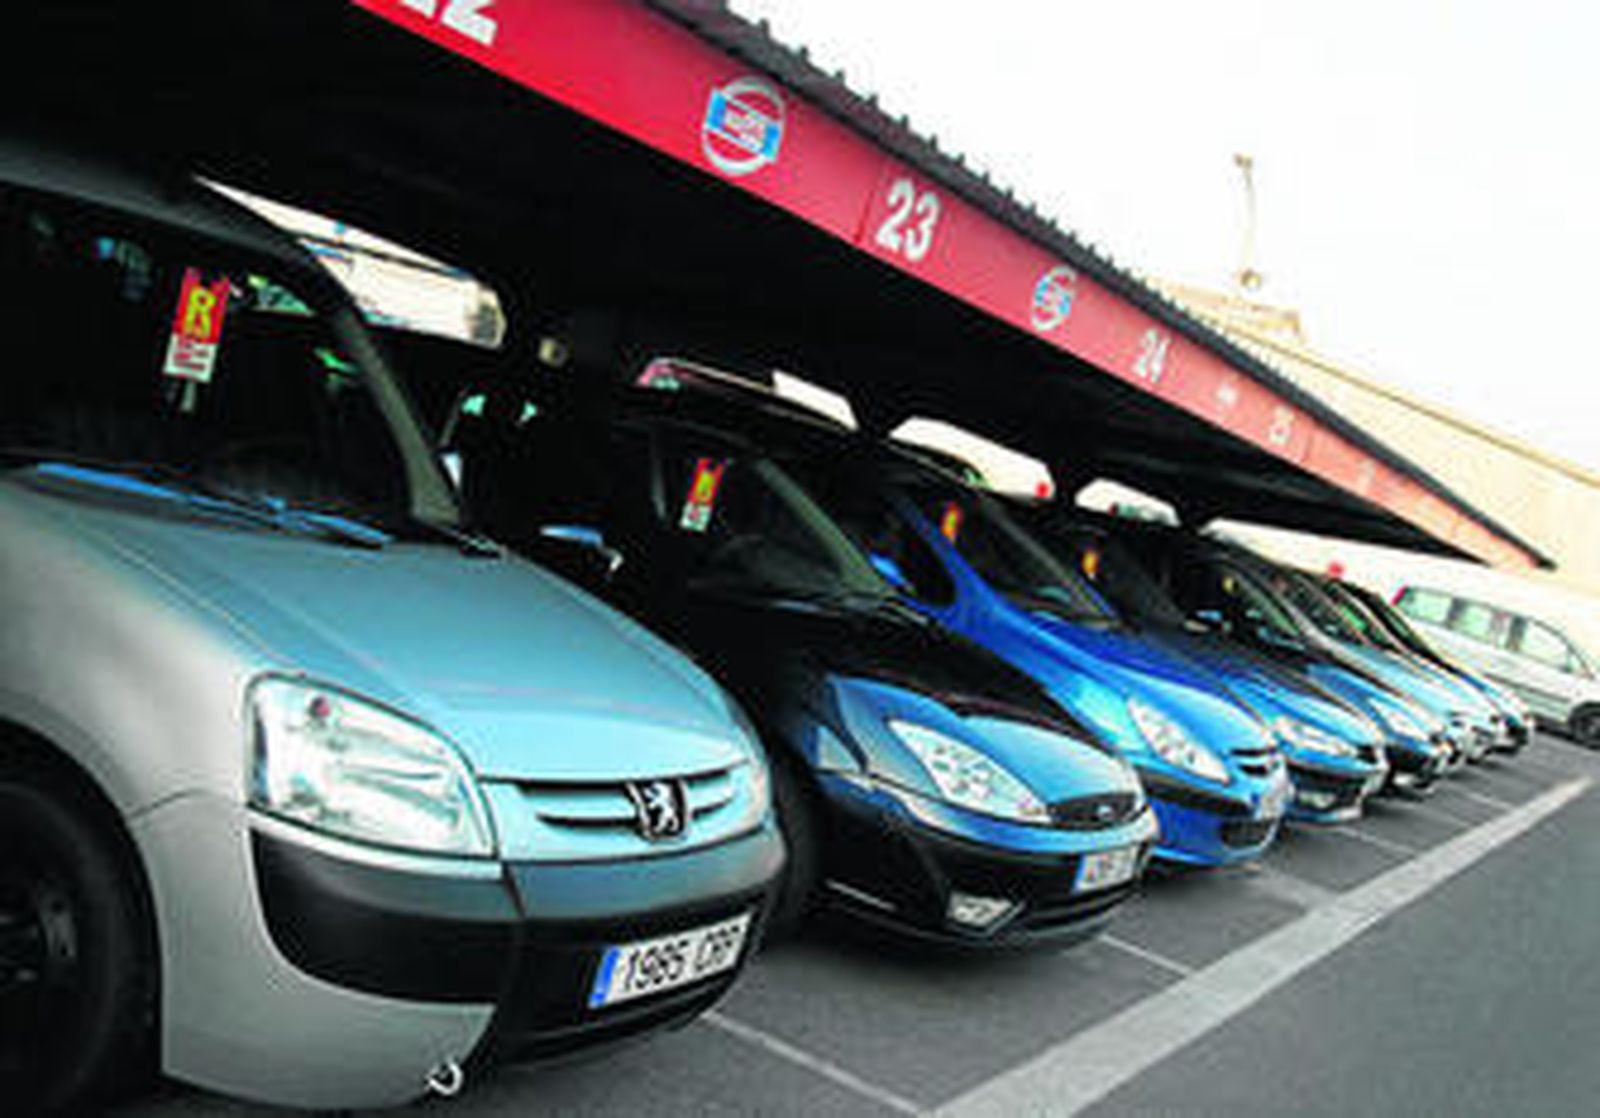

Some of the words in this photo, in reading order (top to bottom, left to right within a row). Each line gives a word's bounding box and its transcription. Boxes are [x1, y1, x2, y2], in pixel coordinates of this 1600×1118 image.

[876, 179, 940, 261] 23
[1131, 327, 1172, 384] 24
[623, 939, 690, 992] 1985
